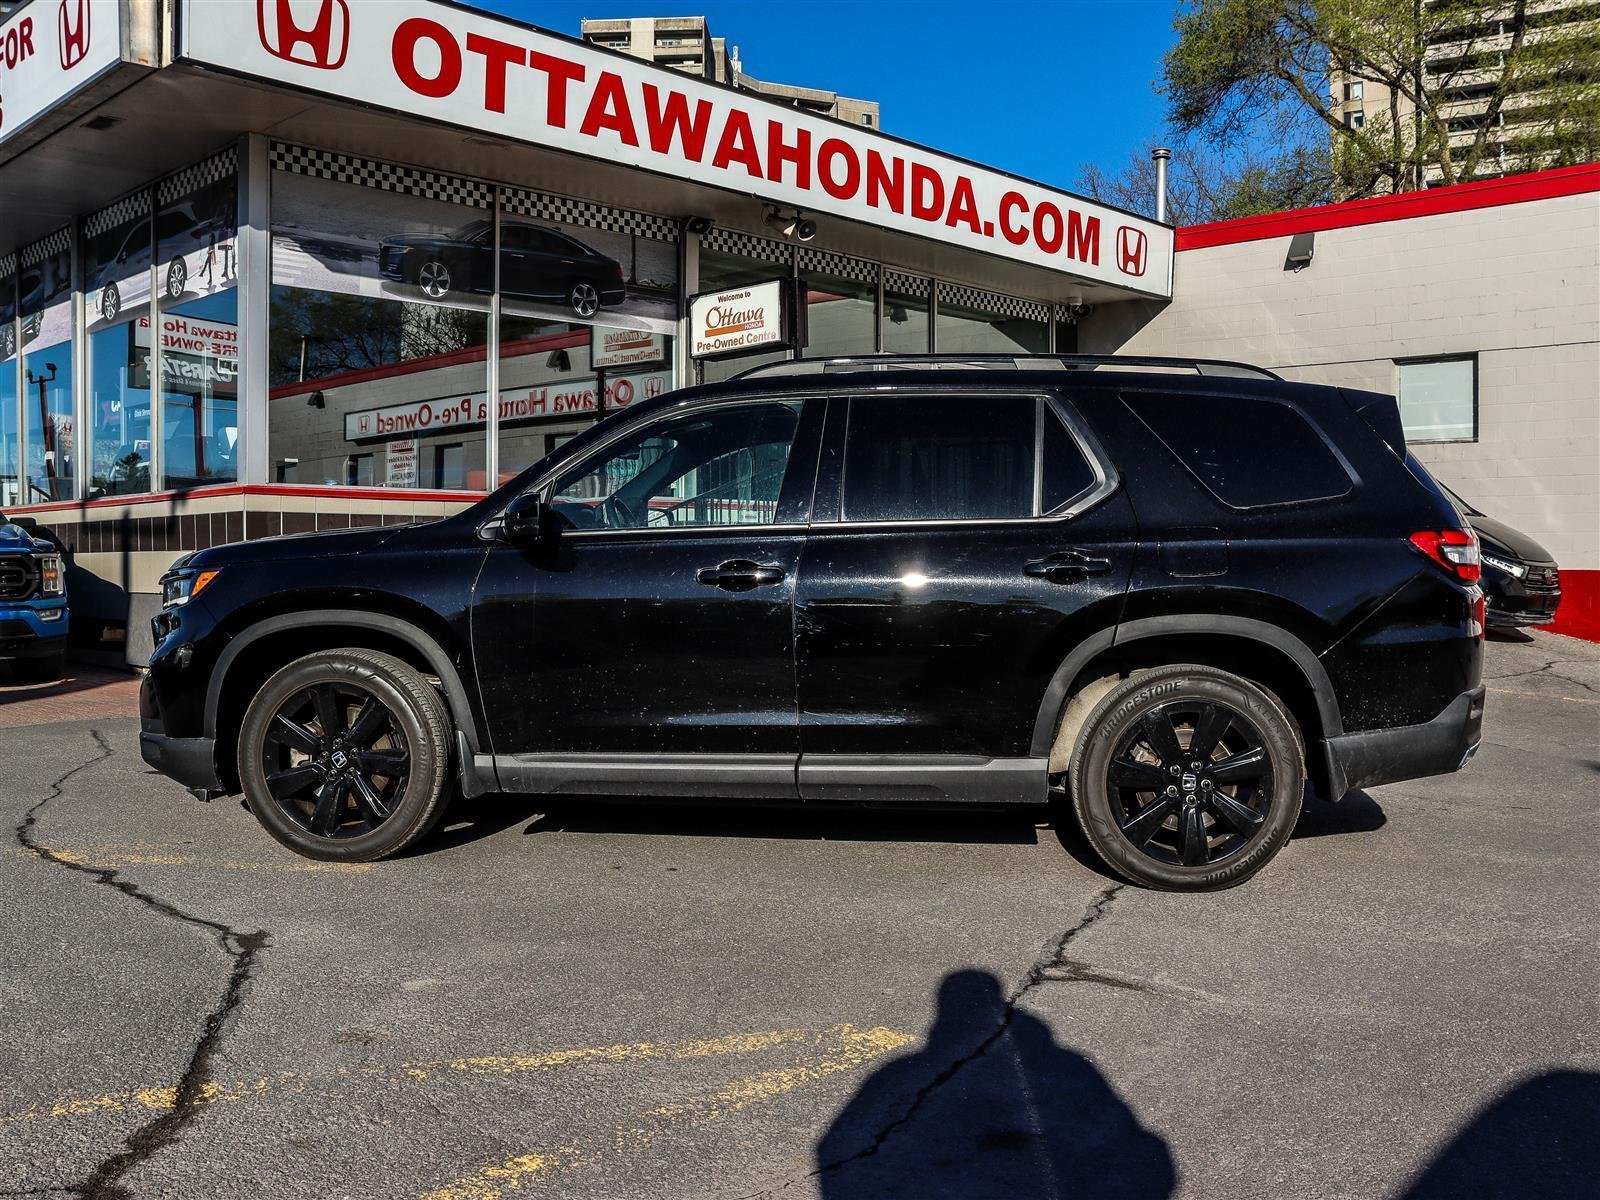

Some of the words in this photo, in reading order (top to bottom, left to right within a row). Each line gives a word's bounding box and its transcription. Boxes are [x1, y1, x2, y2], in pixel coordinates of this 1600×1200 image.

[391, 17, 1101, 266] OTTAWAHONDA.COM
[717, 292, 743, 303] Welcome
[744, 290, 751, 298] to
[705, 305, 764, 329] Ottawa
[744, 321, 764, 330] HONDA
[697, 334, 744, 352] Pre-Owned
[746, 330, 777, 344] Centre
